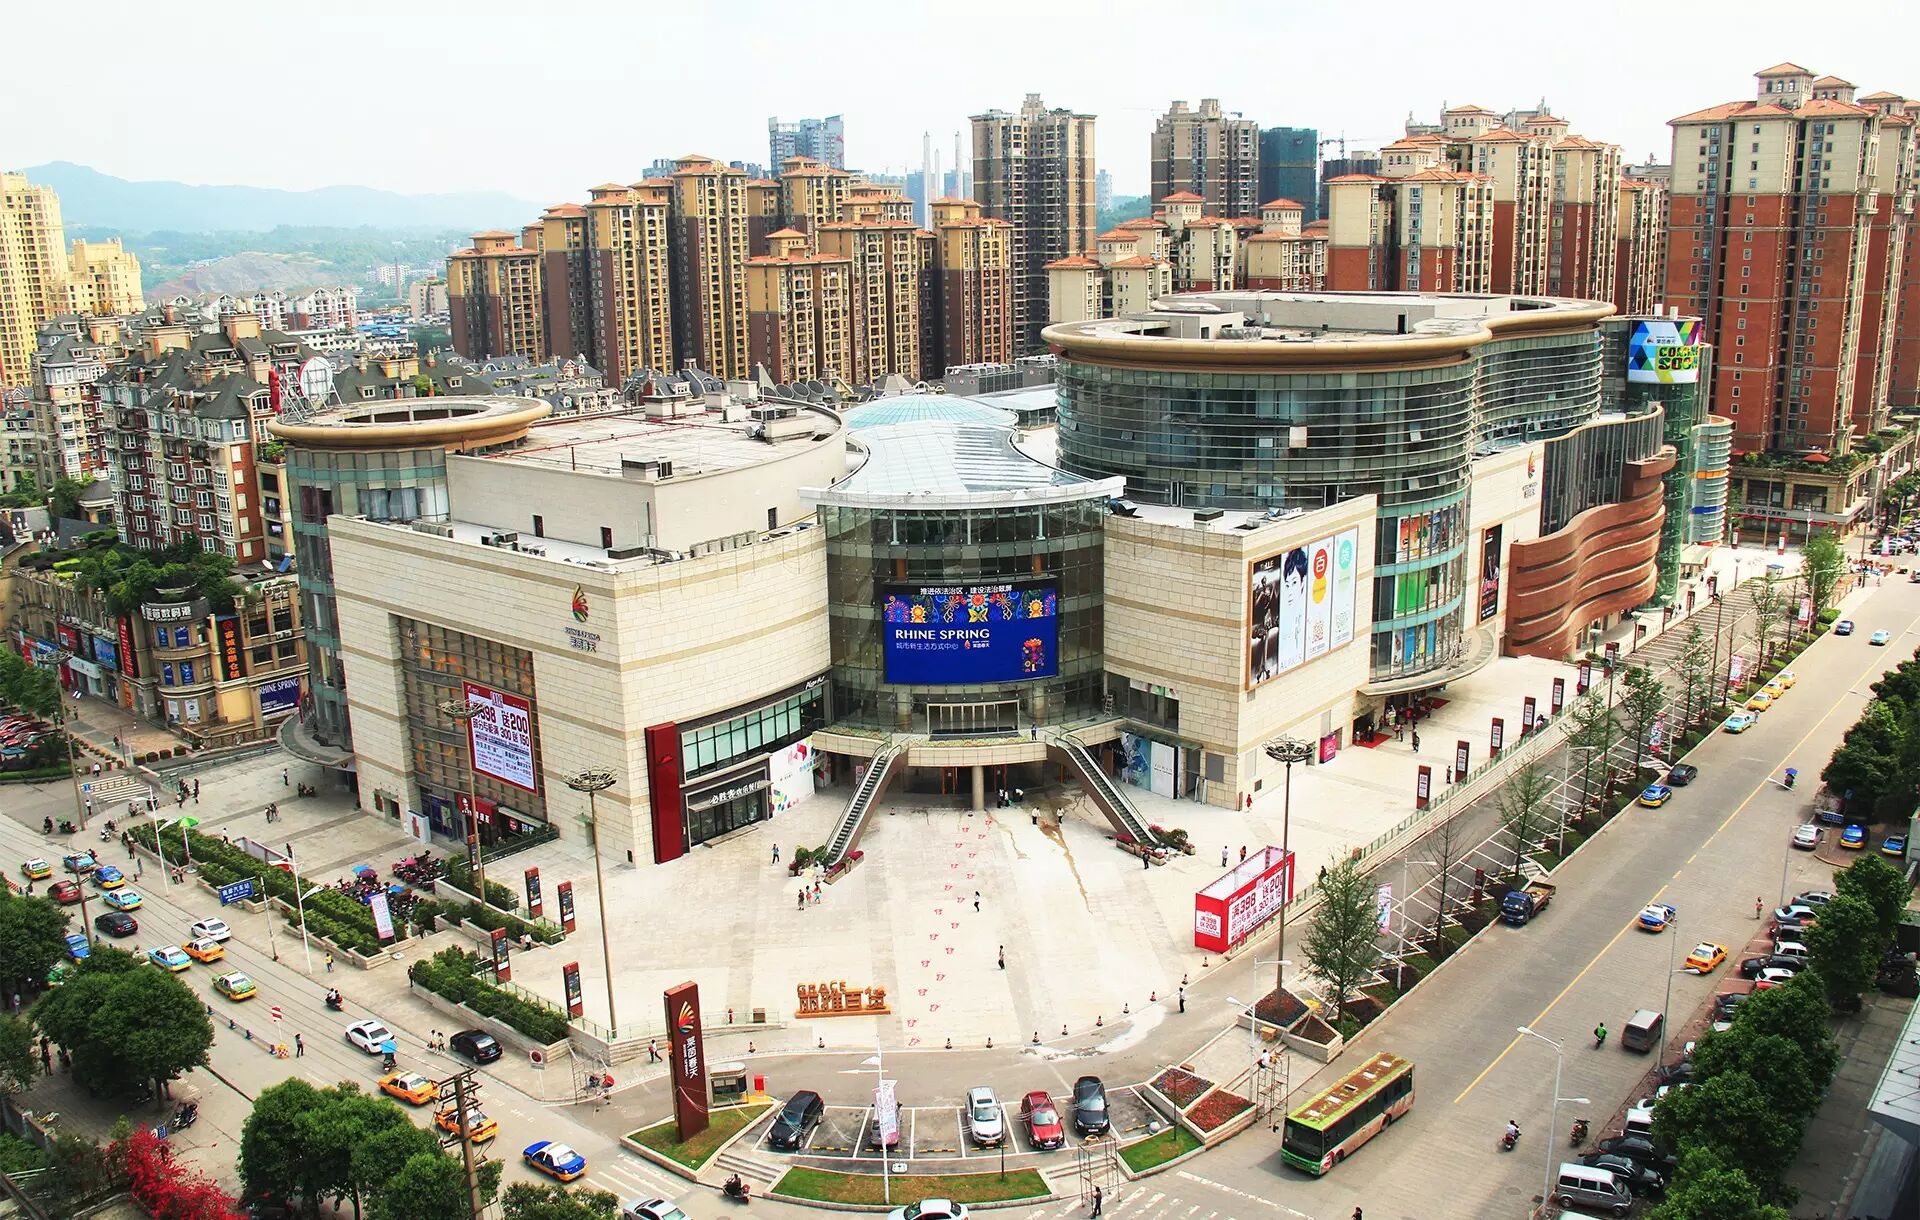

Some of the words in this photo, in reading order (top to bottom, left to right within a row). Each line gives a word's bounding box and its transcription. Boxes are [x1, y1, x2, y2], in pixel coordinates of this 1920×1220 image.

[895, 629, 936, 640] RHINE
[939, 628, 990, 640] SPRING
[260, 683, 278, 695] RHINE
[277, 678, 299, 691] SPRING
[797, 981, 847, 995] GRACE
[798, 986, 887, 1013] 丽雅百货
